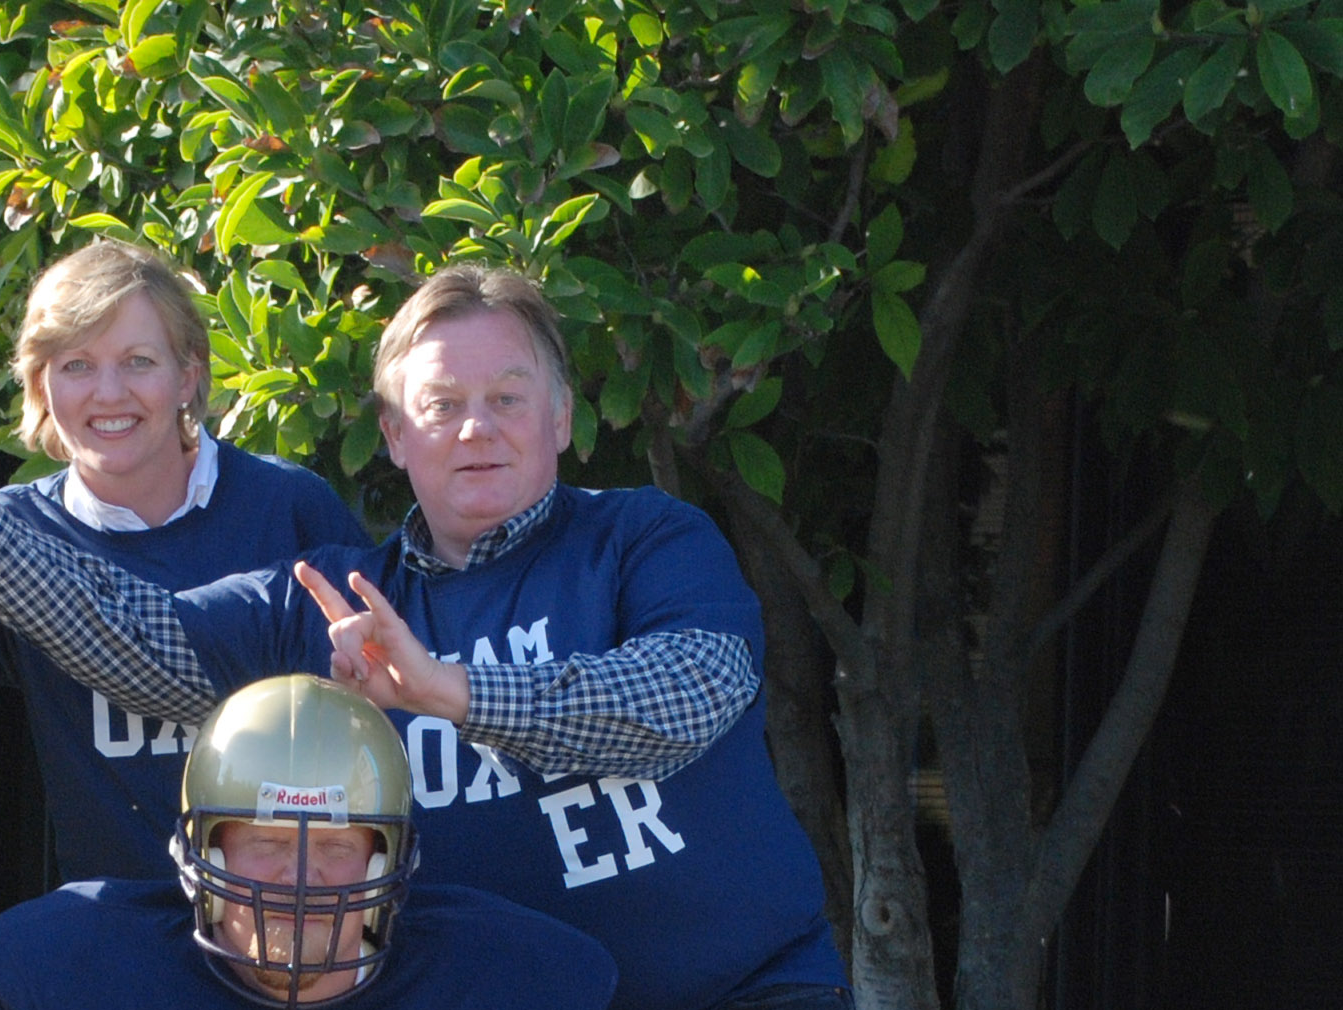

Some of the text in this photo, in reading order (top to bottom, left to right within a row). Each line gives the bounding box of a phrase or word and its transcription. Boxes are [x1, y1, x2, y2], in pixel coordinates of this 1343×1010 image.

[427, 615, 554, 666] AM
[276, 789, 327, 806] Riddell
[407, 715, 569, 810] OX
[538, 777, 686, 889] ER
